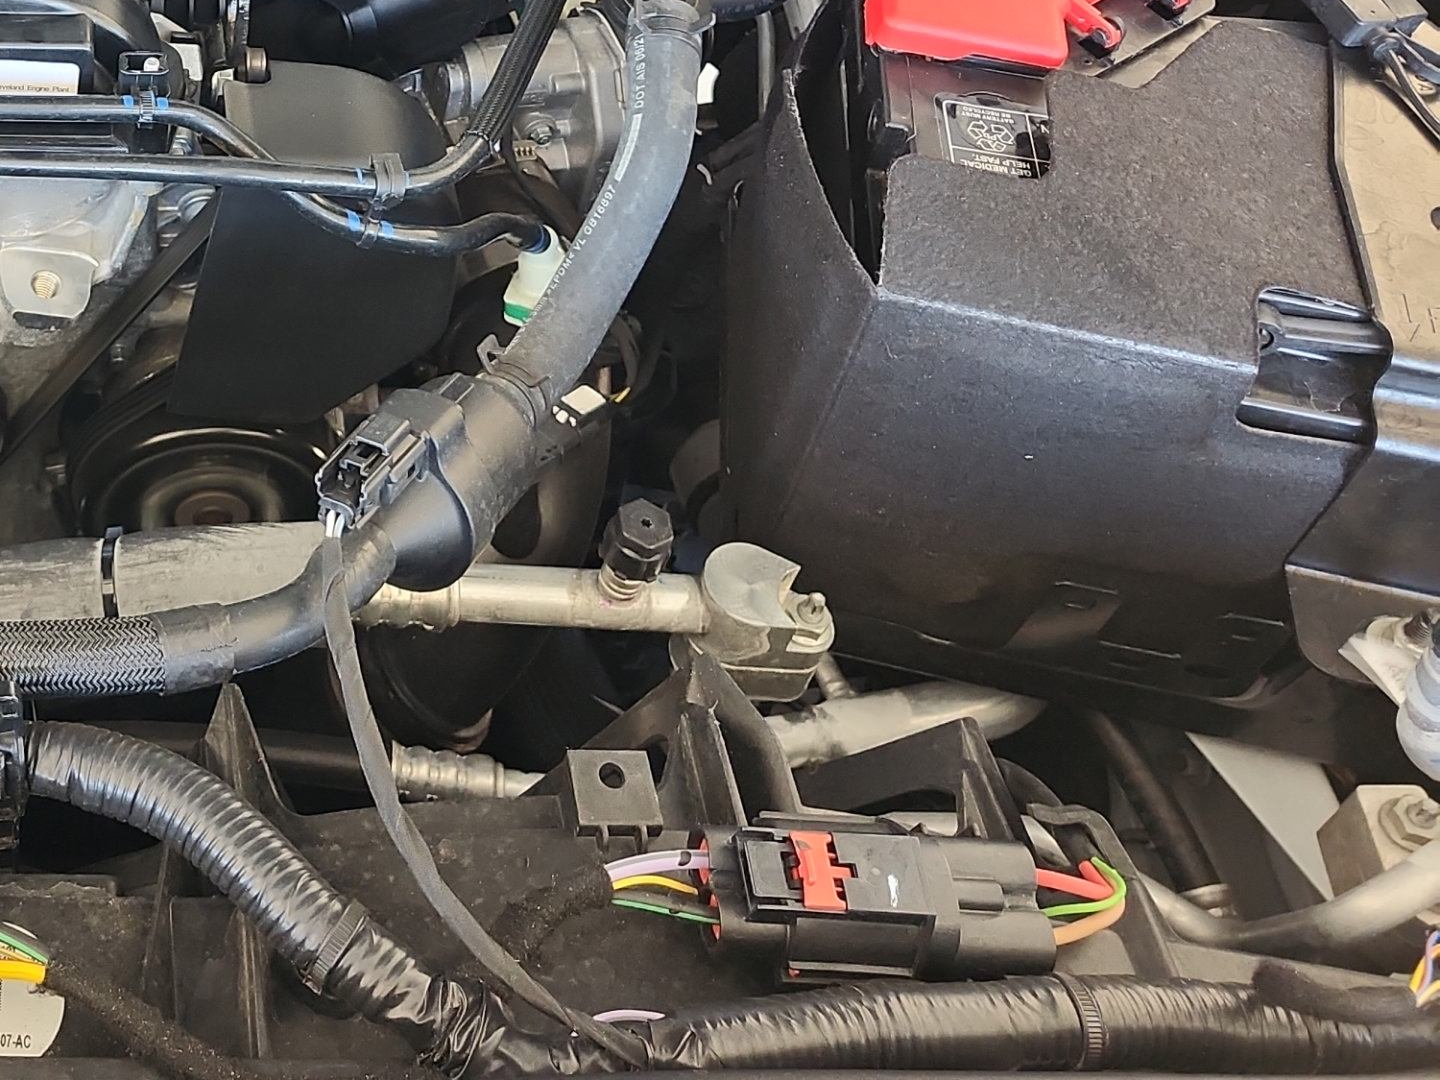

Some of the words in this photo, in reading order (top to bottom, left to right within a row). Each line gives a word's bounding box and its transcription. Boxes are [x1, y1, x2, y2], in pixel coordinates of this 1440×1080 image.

[27, 85, 50, 93] Engine
[52, 85, 70, 93] Plant
[634, 83, 646, 110] DOT
[961, 110, 981, 119] MUST
[982, 114, 1014, 124] BATTERY
[960, 158, 1008, 174] MEDICAL
[1002, 160, 1031, 169] HELP
[1010, 168, 1032, 177] GET
[572, 238, 587, 252] VL
